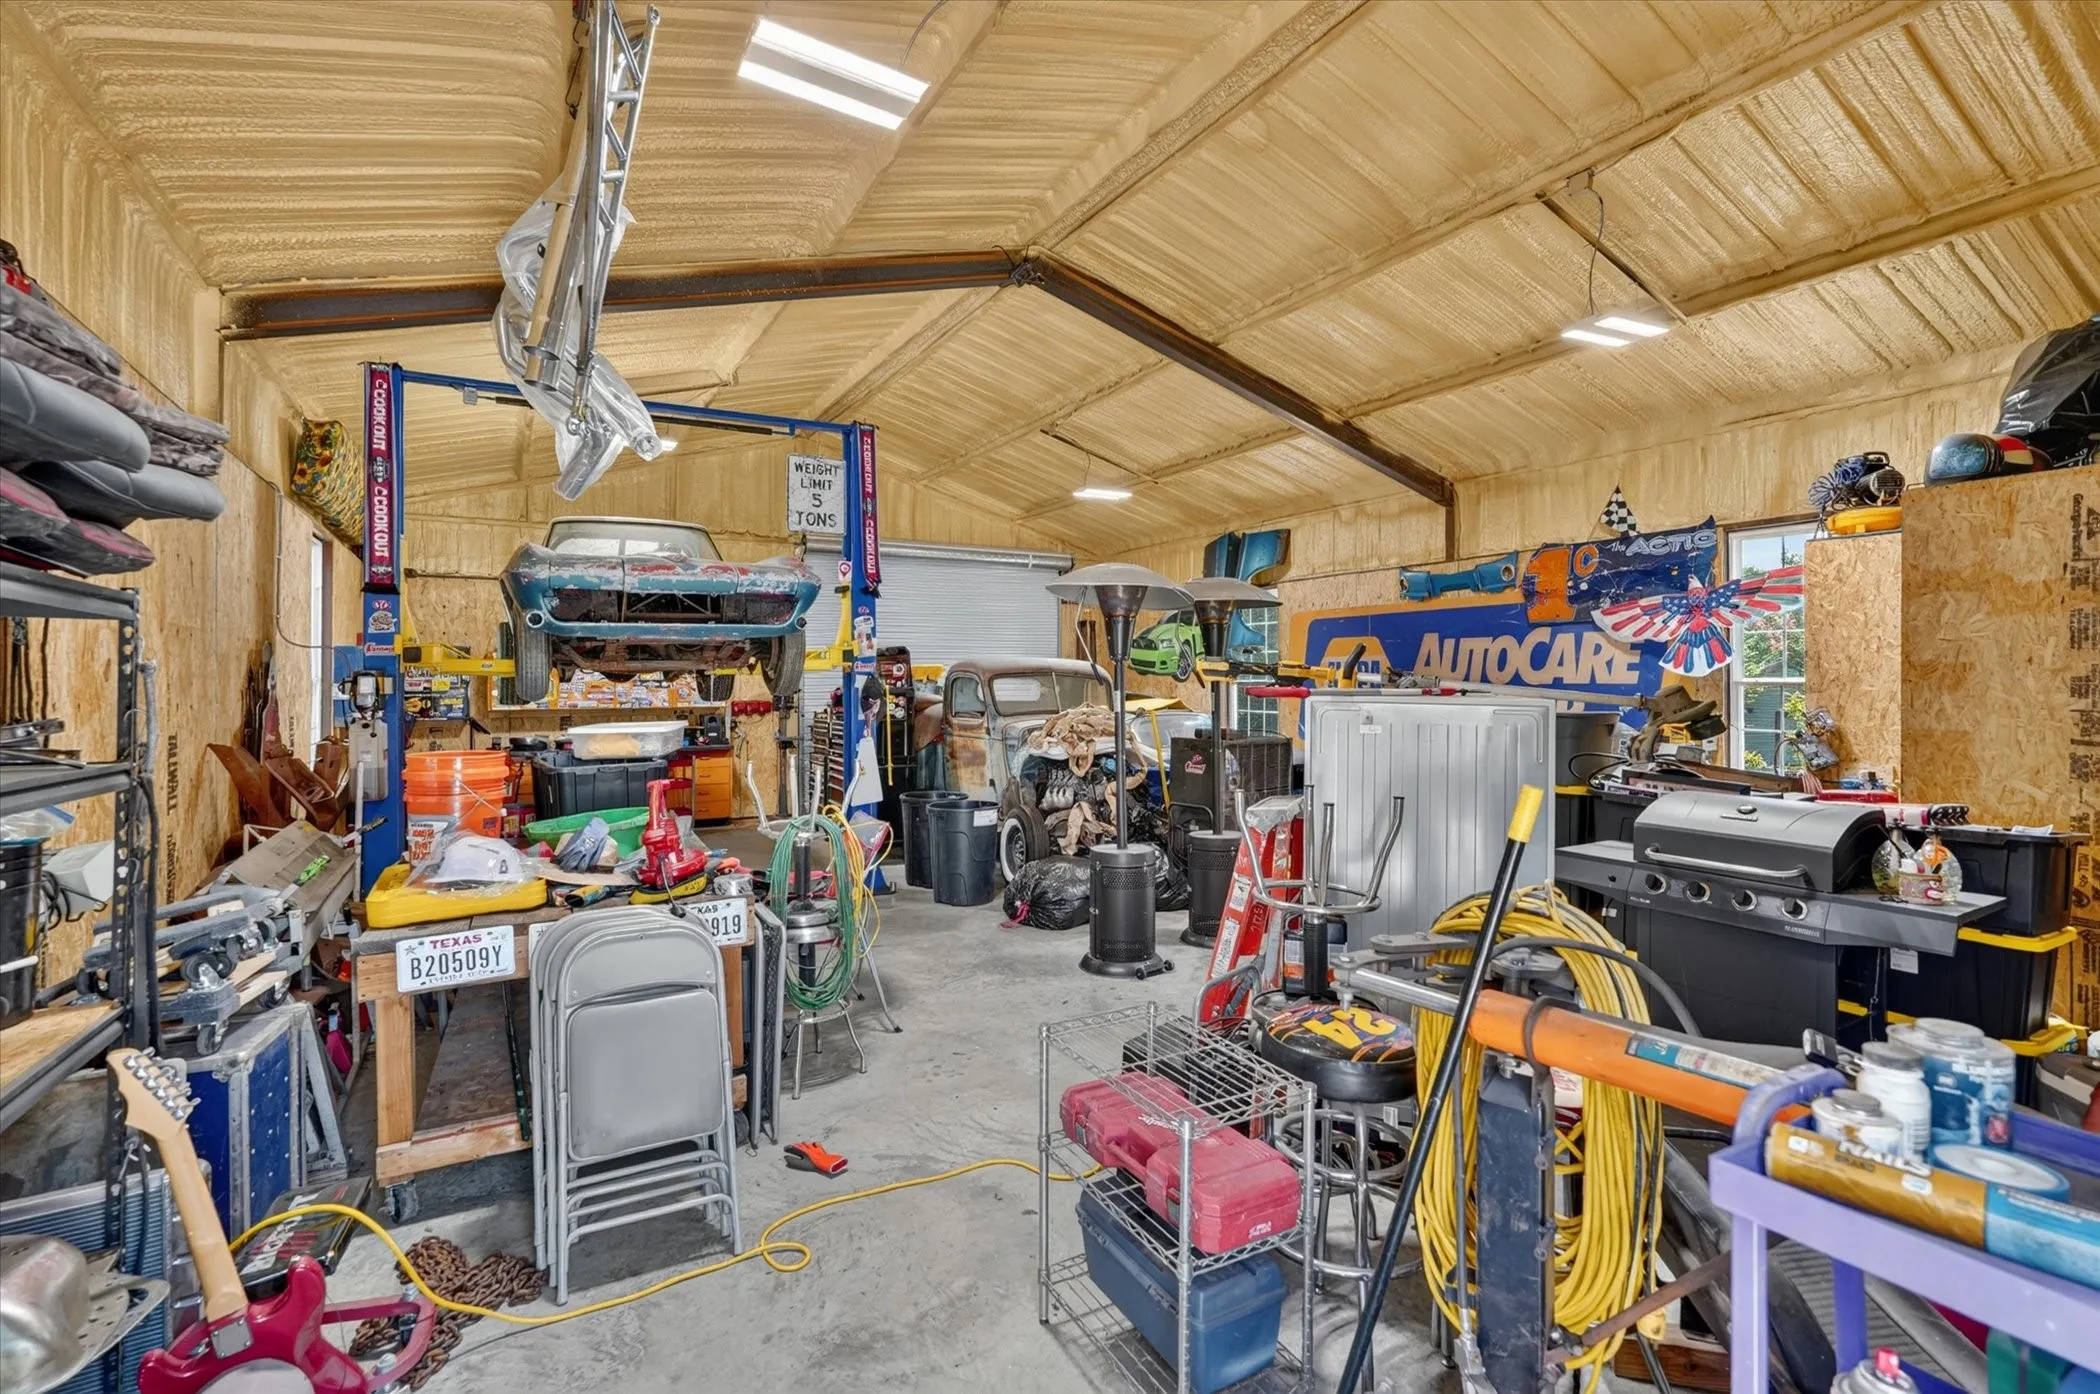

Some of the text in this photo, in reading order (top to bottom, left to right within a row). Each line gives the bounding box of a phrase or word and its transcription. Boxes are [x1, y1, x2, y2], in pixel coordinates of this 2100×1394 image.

[794, 461, 840, 477] WEIGHT
[800, 479, 833, 490] LIMIT
[812, 494, 822, 508] 5
[795, 510, 838, 528] TONS
[1411, 627, 1644, 685] AUTOCARE
[706, 914, 742, 937] 919
[429, 933, 482, 950] TEXAS
[410, 945, 502, 980] B20509Y
